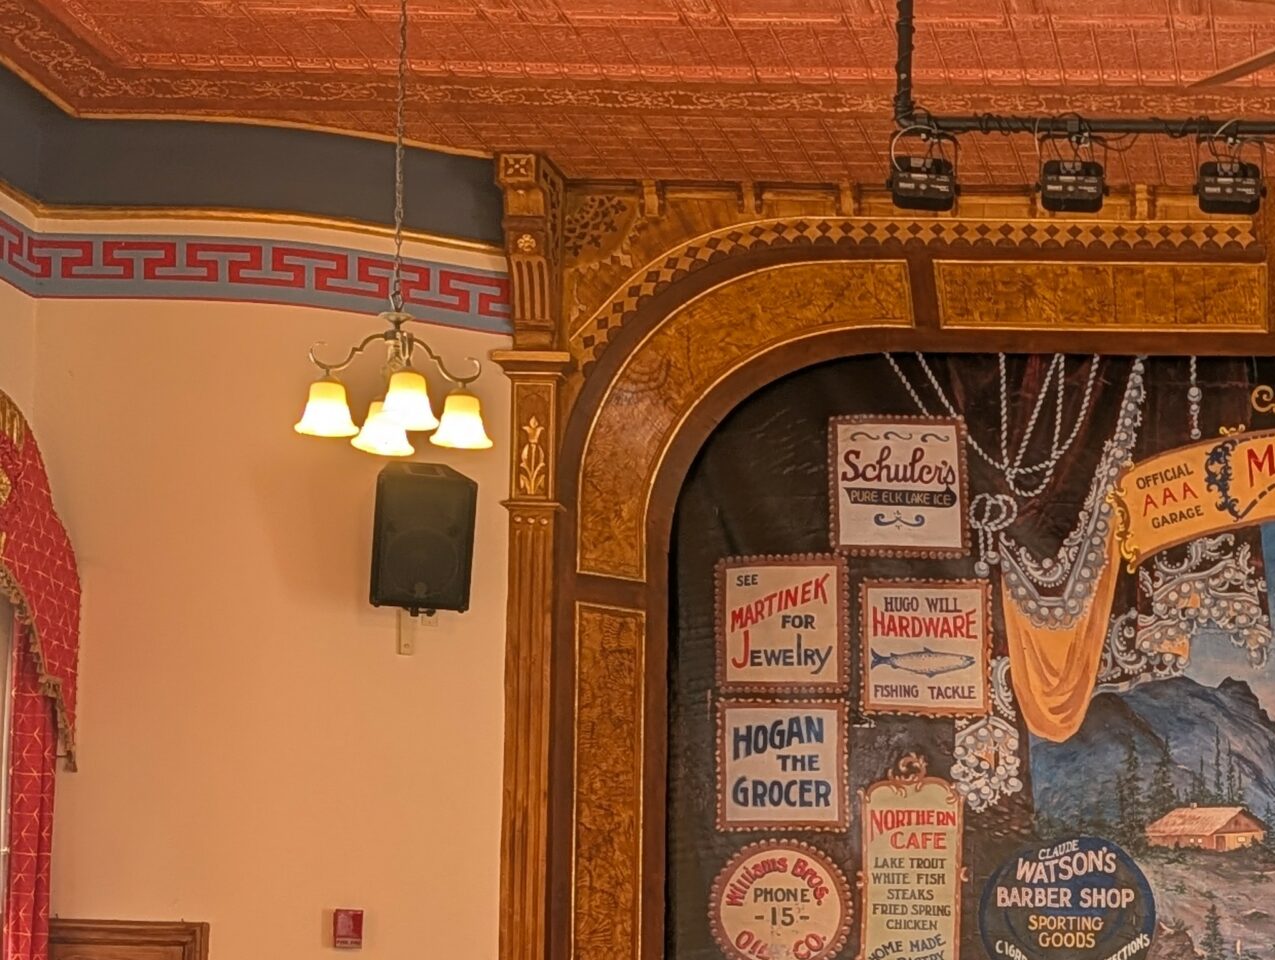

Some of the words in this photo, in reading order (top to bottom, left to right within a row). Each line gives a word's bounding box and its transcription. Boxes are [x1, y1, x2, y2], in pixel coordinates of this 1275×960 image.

[1136, 463, 1194, 490] OFFICIAL
[850, 490, 879, 502] PURE
[881, 491, 903, 503] ELK
[905, 491, 930, 505] LAKE
[933, 493, 952, 506] ICE
[1152, 504, 1204, 530] GARAGE
[736, 574, 759, 587] SEE
[731, 572, 830, 633] MARTINEK
[884, 596, 920, 613] HUGO
[925, 597, 963, 613] WILL
[781, 614, 816, 630] FOR
[872, 606, 978, 640] HARDWARE
[874, 684, 920, 699] FISHING
[927, 685, 977, 700] TACKLE
[732, 715, 824, 762] HOGAN
[776, 754, 821, 772] THE
[732, 776, 832, 809] GROCER
[870, 809, 956, 842] NORTHERN
[890, 831, 947, 850] CAFE
[1038, 839, 1080, 861] CLAUDE
[873, 856, 905, 870] LAKE
[909, 857, 947, 870] TROUT
[1016, 846, 1117, 884] WATSON'S
[871, 872, 911, 885] WHITE
[916, 873, 946, 885] FISH
[753, 887, 811, 904] PHONE
[886, 889, 934, 901] STEAKS
[996, 886, 1072, 908] BARBER
[1079, 887, 1135, 909] SHOP
[872, 903, 909, 916] FRIED
[910, 903, 951, 917] SPRING
[886, 919, 938, 930] CHICKEN
[1028, 914, 1104, 931] SPORTING
[909, 933, 947, 953] MADE
[1038, 932, 1096, 949] GOODS
